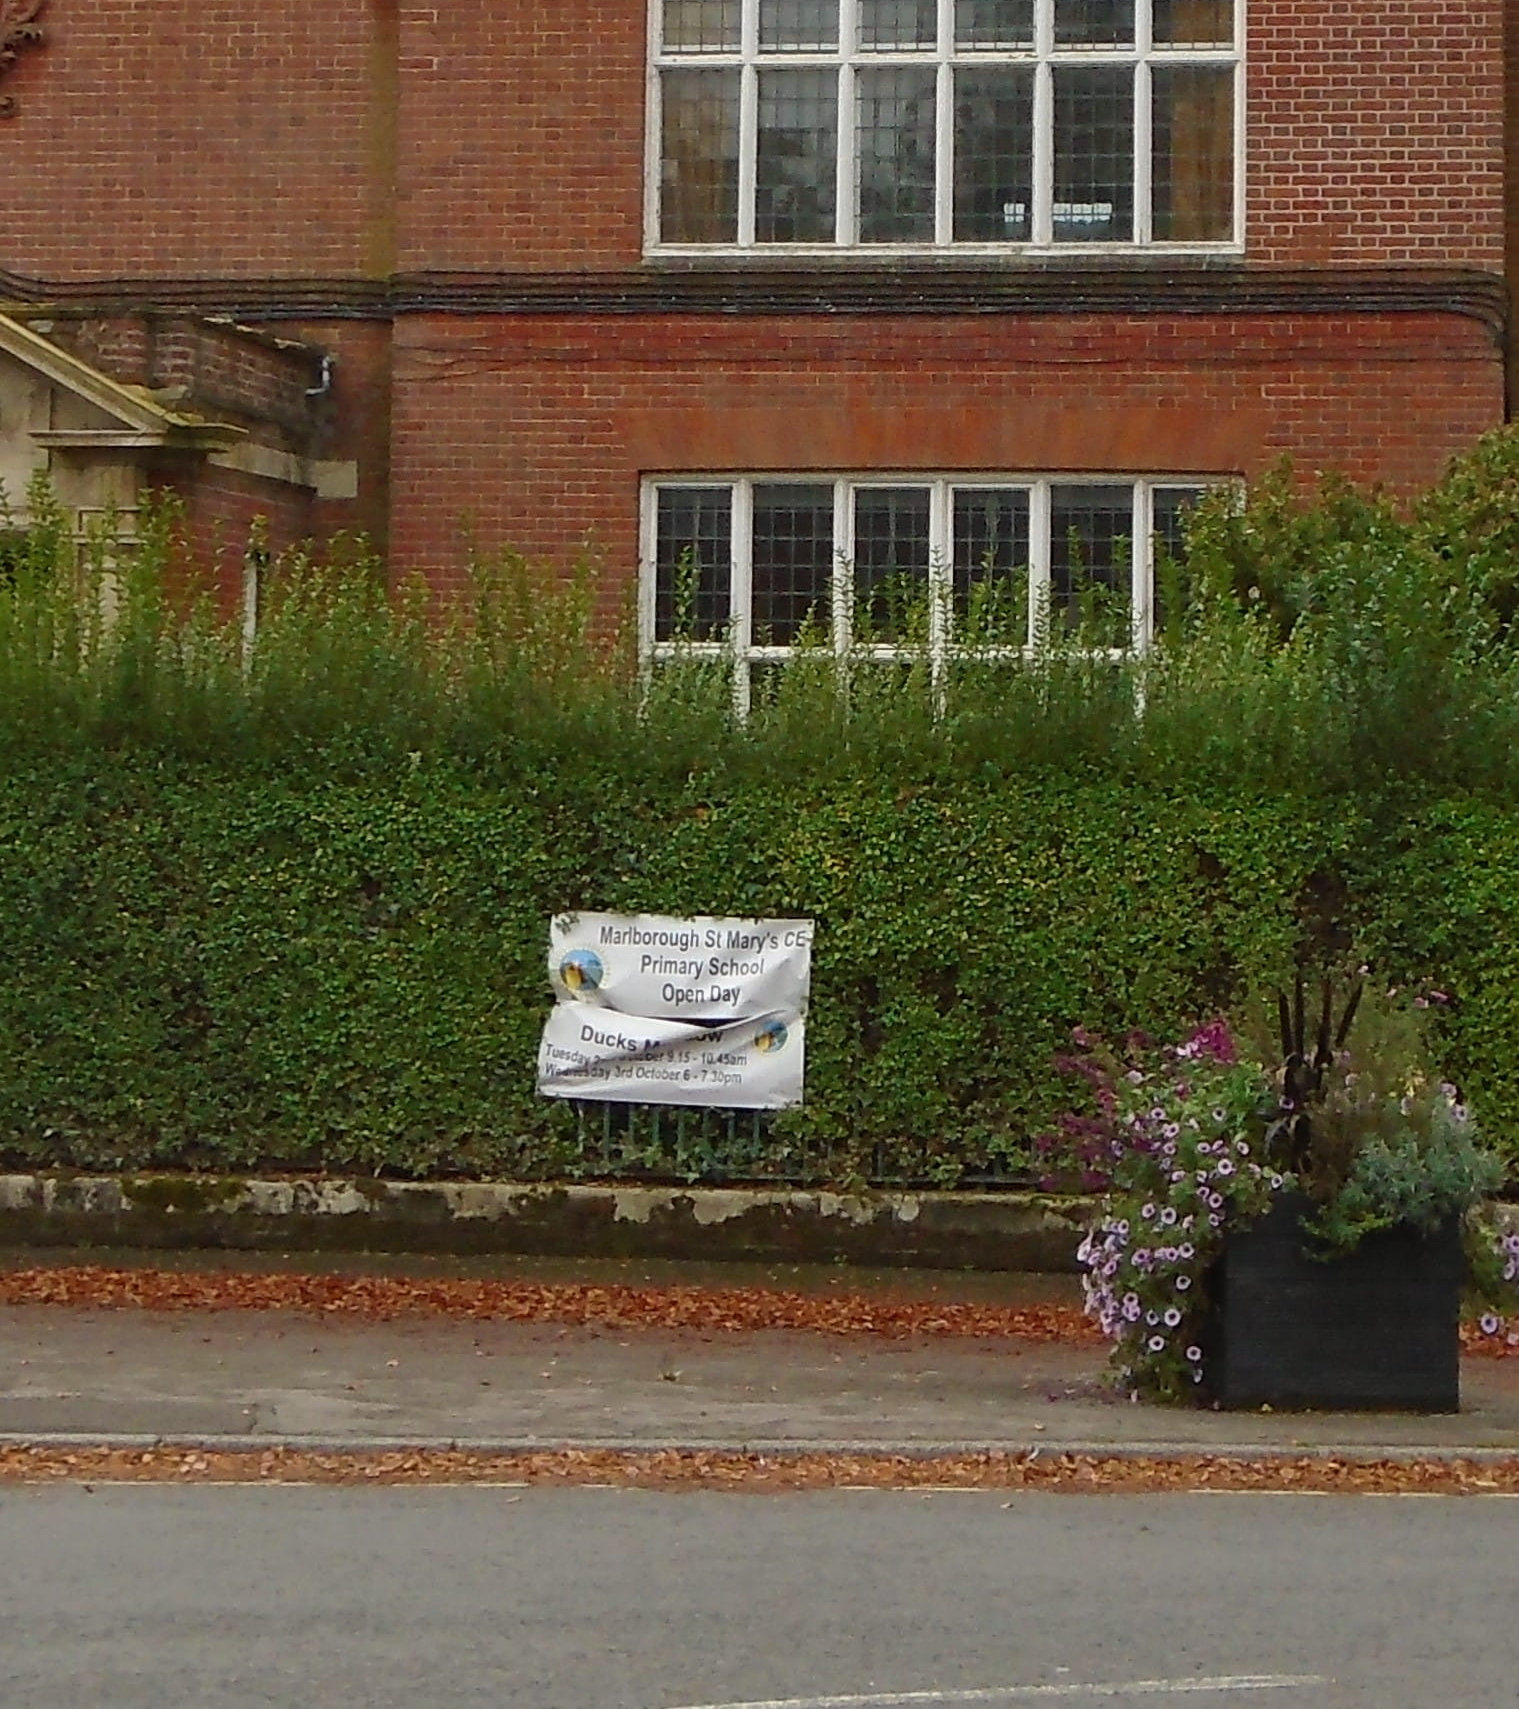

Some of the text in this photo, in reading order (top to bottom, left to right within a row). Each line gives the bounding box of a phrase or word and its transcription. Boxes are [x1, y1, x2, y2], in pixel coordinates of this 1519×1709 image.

[600, 926, 806, 954] Marlborough St Mary's CE
[640, 955, 765, 980] Primary School
[662, 983, 741, 1006] Open Day
[580, 1024, 638, 1052] Ducks
[545, 1043, 589, 1066] Tuesday
[701, 1052, 747, 1065] 10.45am
[636, 1067, 681, 1081] October
[683, 1069, 690, 1081] 6
